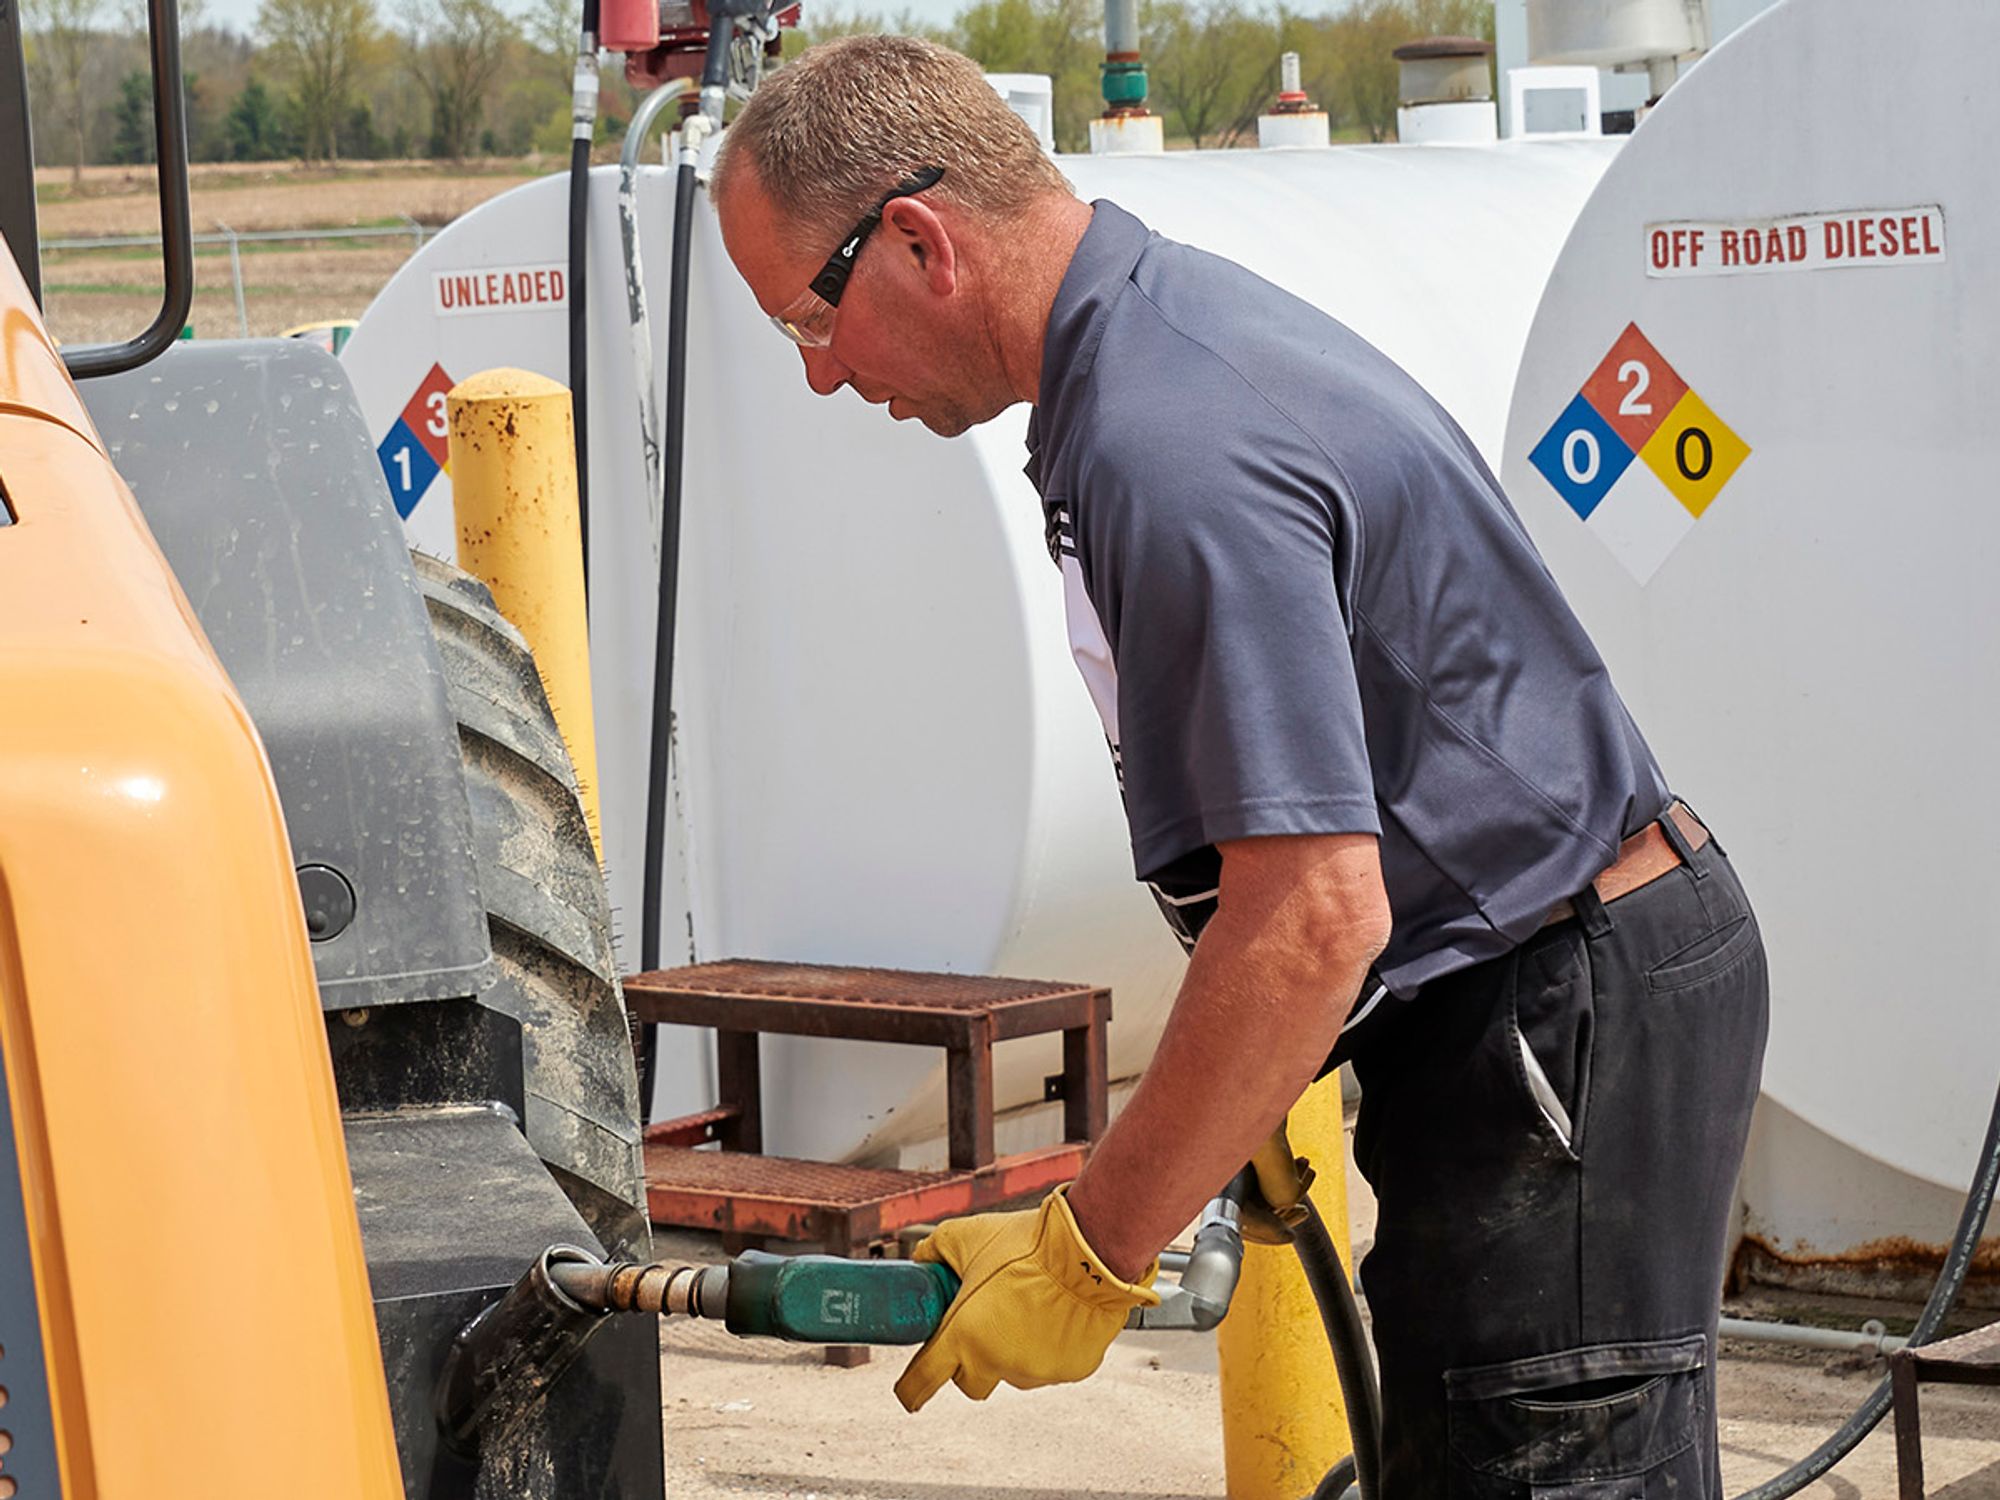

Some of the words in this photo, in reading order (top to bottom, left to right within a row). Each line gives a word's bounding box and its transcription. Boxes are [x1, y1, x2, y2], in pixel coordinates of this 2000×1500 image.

[1651, 230, 1704, 269] OFF
[1721, 226, 1807, 266] ROAD
[1823, 216, 1941, 260] DIESEL
[439, 270, 565, 309] UNLEADED
[426, 391, 449, 437] 3
[1617, 360, 1652, 415] 2
[393, 447, 412, 491] 1
[1562, 429, 1600, 484] 0
[1675, 427, 1713, 481] 0
